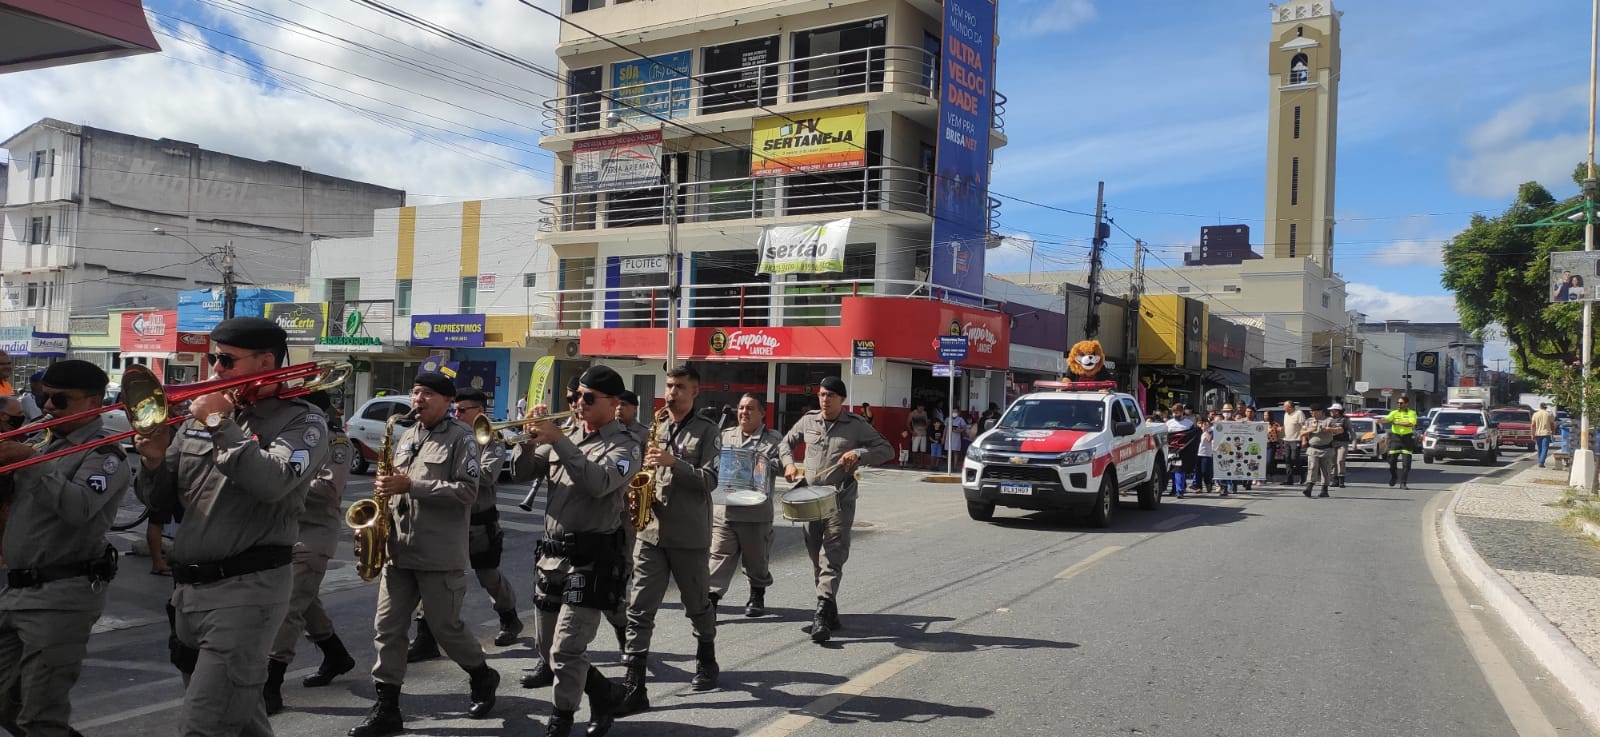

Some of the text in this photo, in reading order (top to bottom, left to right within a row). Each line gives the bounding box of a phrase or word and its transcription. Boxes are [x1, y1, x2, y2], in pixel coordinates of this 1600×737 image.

[950, 0, 977, 27] VEM PRO
[950, 15, 974, 40] MUNDO
[949, 35, 982, 72] ULTRA
[948, 62, 986, 97] VELOCI
[948, 88, 978, 116] DADE
[796, 117, 821, 136] TV
[947, 112, 962, 129] VEM
[763, 130, 853, 152] SERTANEJA
[946, 128, 977, 152] BRISANET
[766, 239, 828, 260] sertão
[433, 321, 482, 333] EMPRÉSTIMOS
[0, 341, 28, 352] undial
[728, 330, 781, 351] Empório
[749, 346, 774, 356] LANCHES
